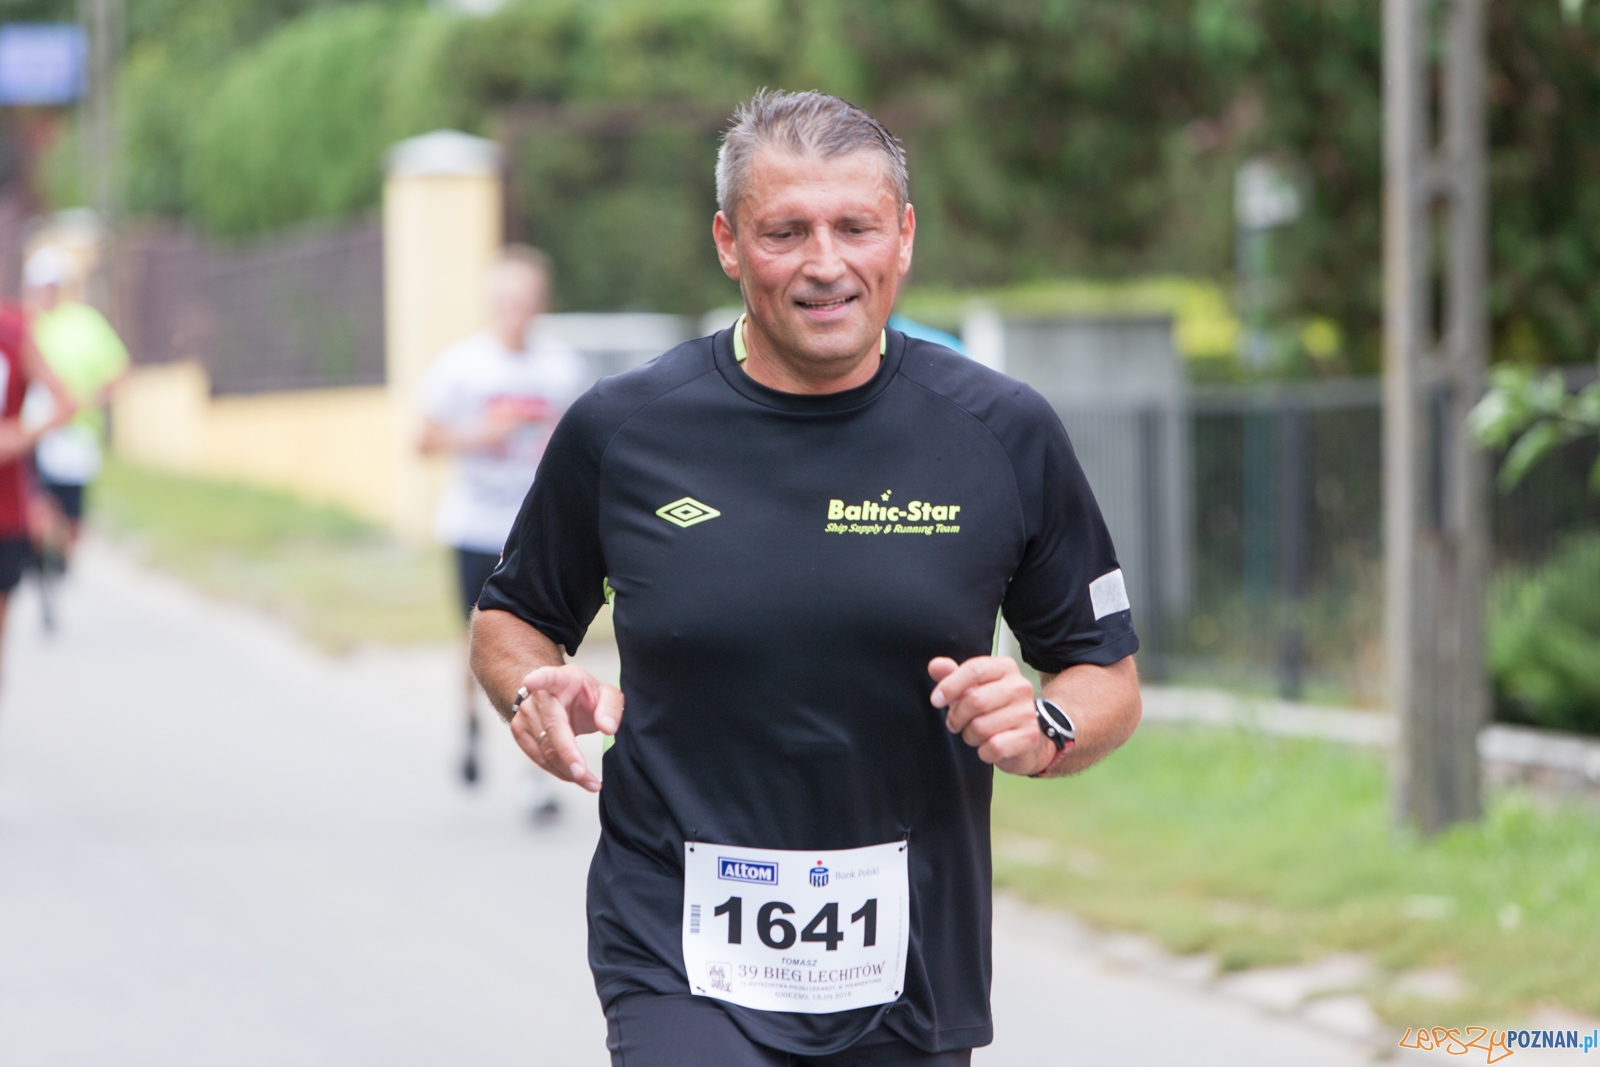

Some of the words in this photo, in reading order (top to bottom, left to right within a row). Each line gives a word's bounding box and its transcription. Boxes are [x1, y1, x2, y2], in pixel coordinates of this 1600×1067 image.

[827, 498, 961, 522] Baltic-Star
[824, 522, 848, 535] Ship
[848, 523, 883, 535] Supply
[883, 524, 892, 534] &
[893, 524, 934, 536] Running
[935, 523, 961, 534] Team
[835, 870, 855, 880] Bank
[858, 866, 880, 878] Polski
[714, 896, 878, 952] 1641
[781, 957, 818, 967] TOMASZ
[738, 964, 758, 979] 39
[764, 966, 802, 983] BIEG
[808, 960, 886, 983] LECHITÓW
